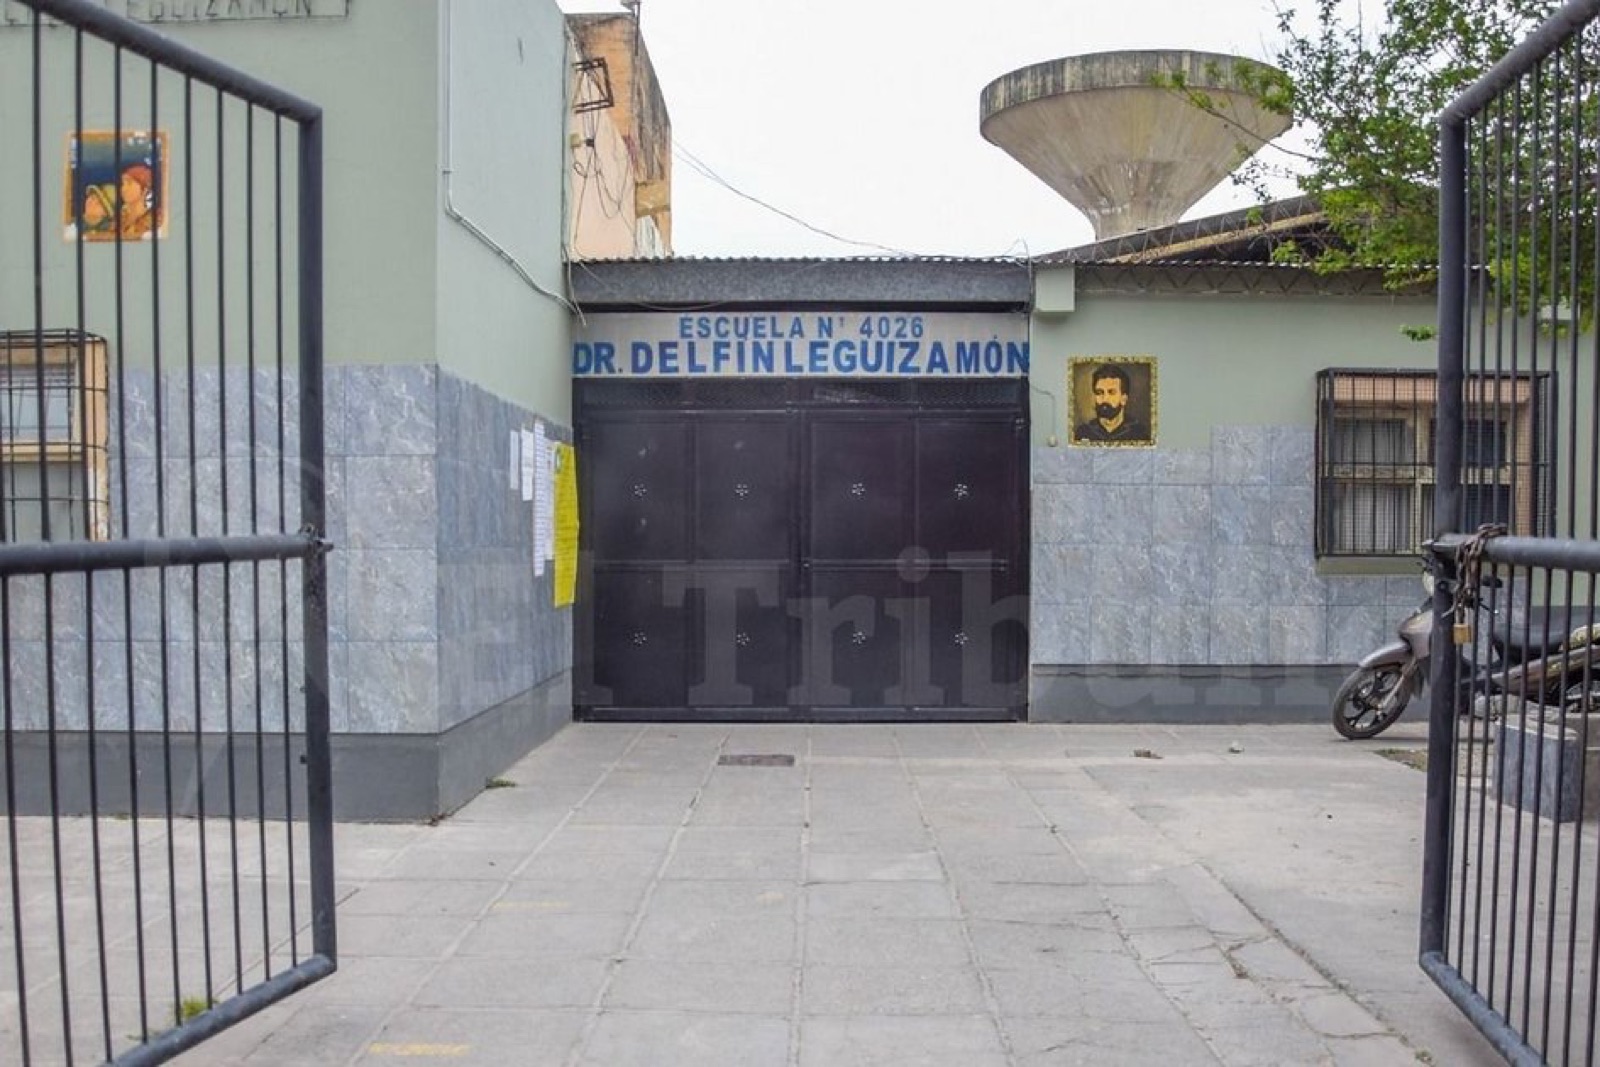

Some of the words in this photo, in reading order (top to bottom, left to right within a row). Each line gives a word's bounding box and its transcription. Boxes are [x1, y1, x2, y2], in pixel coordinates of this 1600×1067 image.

[679, 316, 805, 340] ESCUELA
[859, 316, 924, 340] 4026
[573, 341, 623, 374] DR.
[631, 341, 775, 374] DELFIN
[784, 335, 1029, 374] LEGUIZAMÓN
